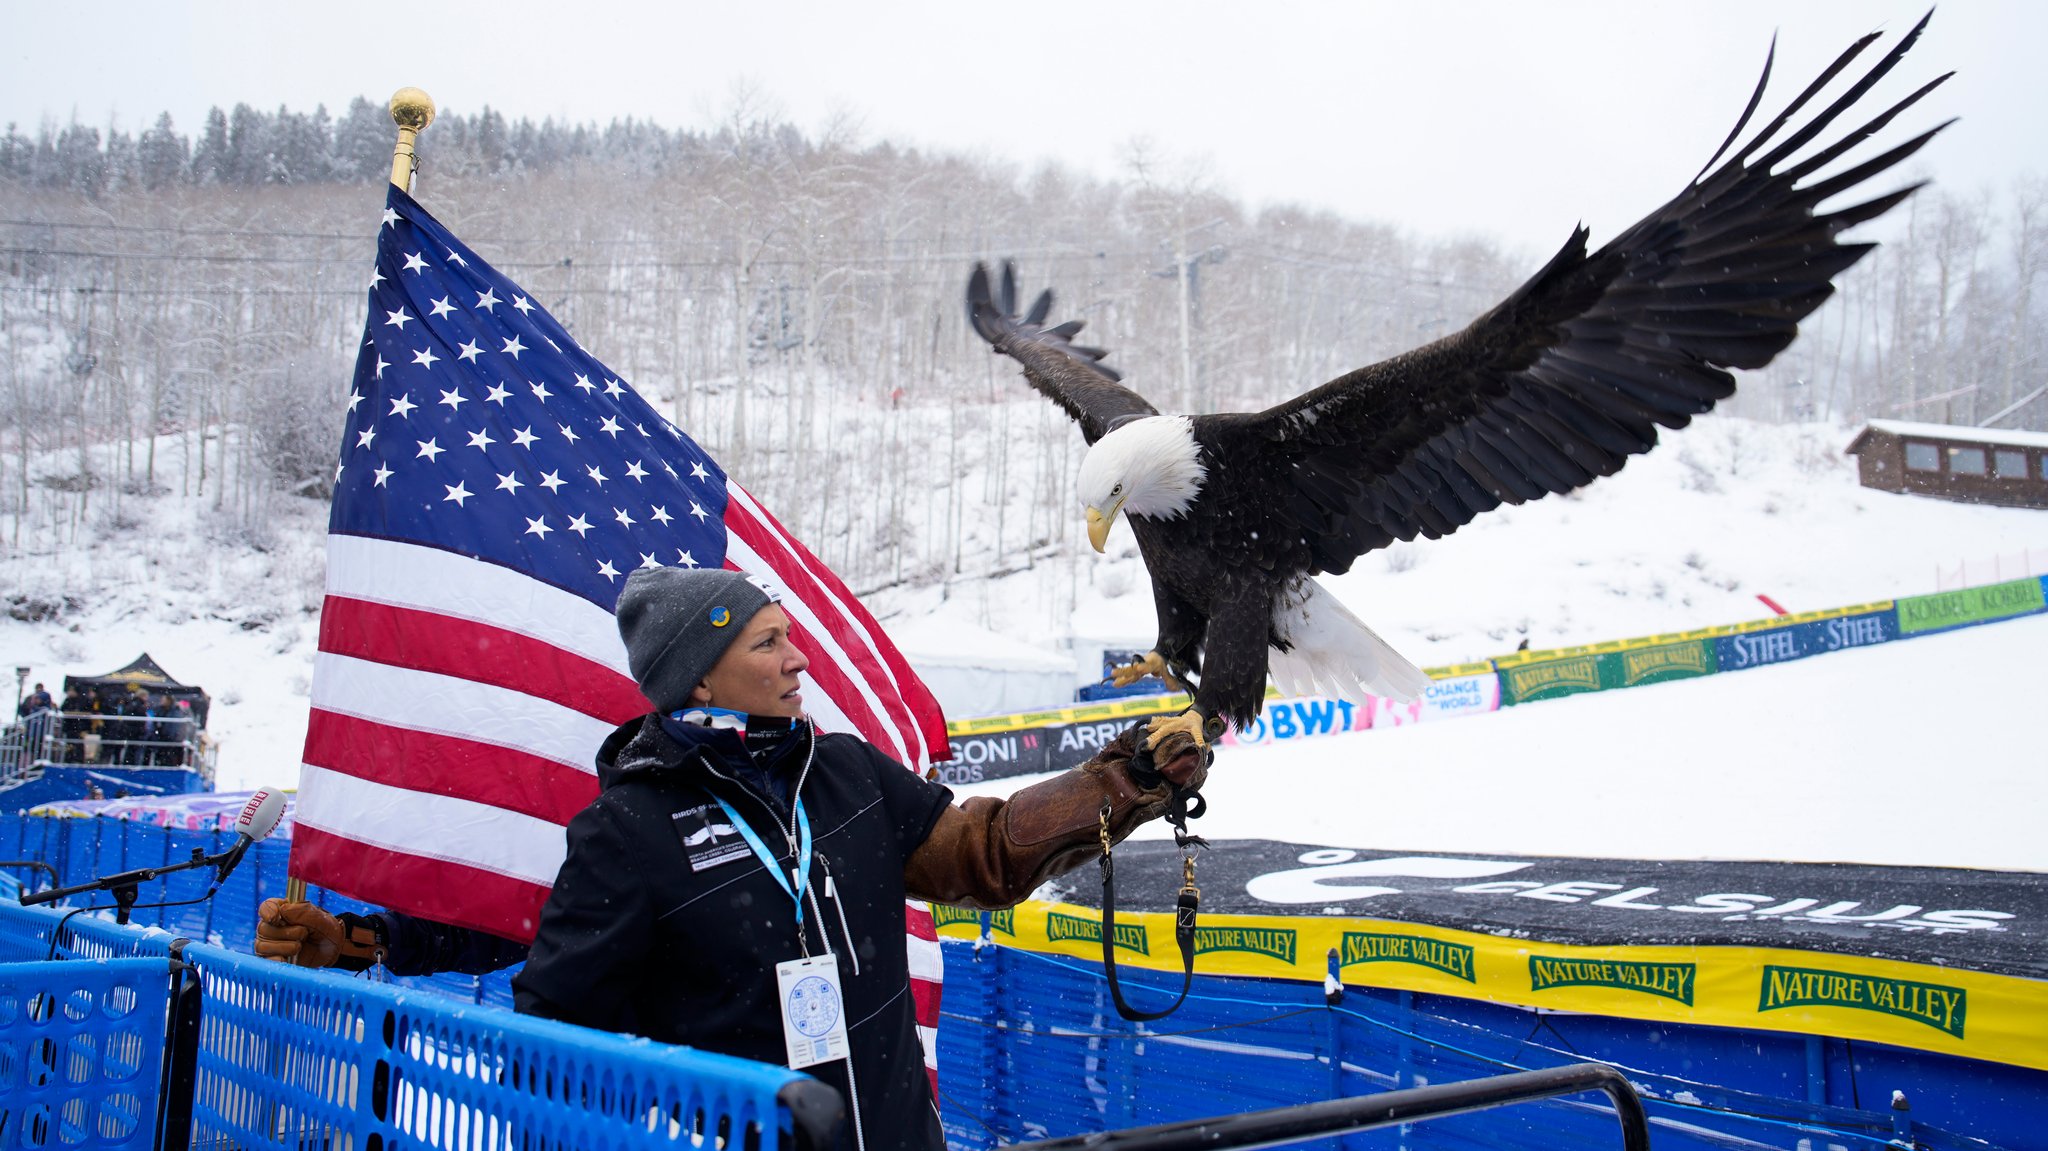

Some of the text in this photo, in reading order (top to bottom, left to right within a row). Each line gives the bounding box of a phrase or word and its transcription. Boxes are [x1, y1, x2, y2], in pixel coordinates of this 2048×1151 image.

[1628, 646, 1699, 674] NATURE VALLEY
[1734, 616, 1887, 667] STIFEL STIFEL
[1514, 666, 1555, 696] NATURE
[1556, 661, 1594, 683] VALLEY
[1269, 699, 1355, 739] BWT
[672, 807, 697, 820] BIRDS
[1453, 881, 2017, 929] CELSIUS
[1050, 916, 1099, 940] NATURE
[1194, 930, 1294, 960] NATURE VALLEY
[1346, 936, 1474, 977] NATURE VALLEY
[1536, 960, 1692, 1000] NATURE VALLEY
[1767, 969, 1960, 1031] NATURE VALLEY
